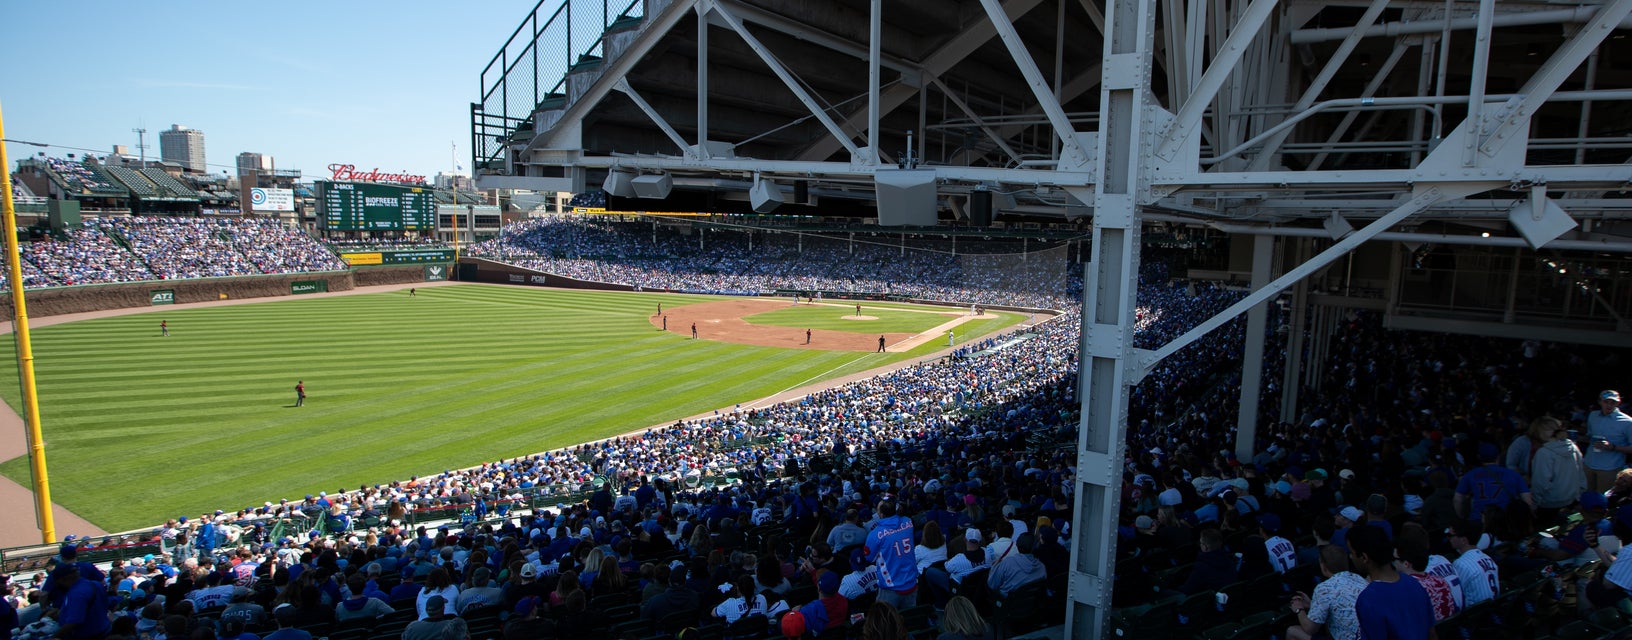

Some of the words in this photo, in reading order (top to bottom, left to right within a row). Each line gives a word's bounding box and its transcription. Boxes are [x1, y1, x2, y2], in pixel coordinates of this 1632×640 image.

[328, 163, 426, 185] Budweiser
[365, 196, 399, 204] BIOFREEZE
[1475, 480, 1504, 501] 17
[894, 538, 912, 557] 15
[857, 571, 879, 588] BRYAN
